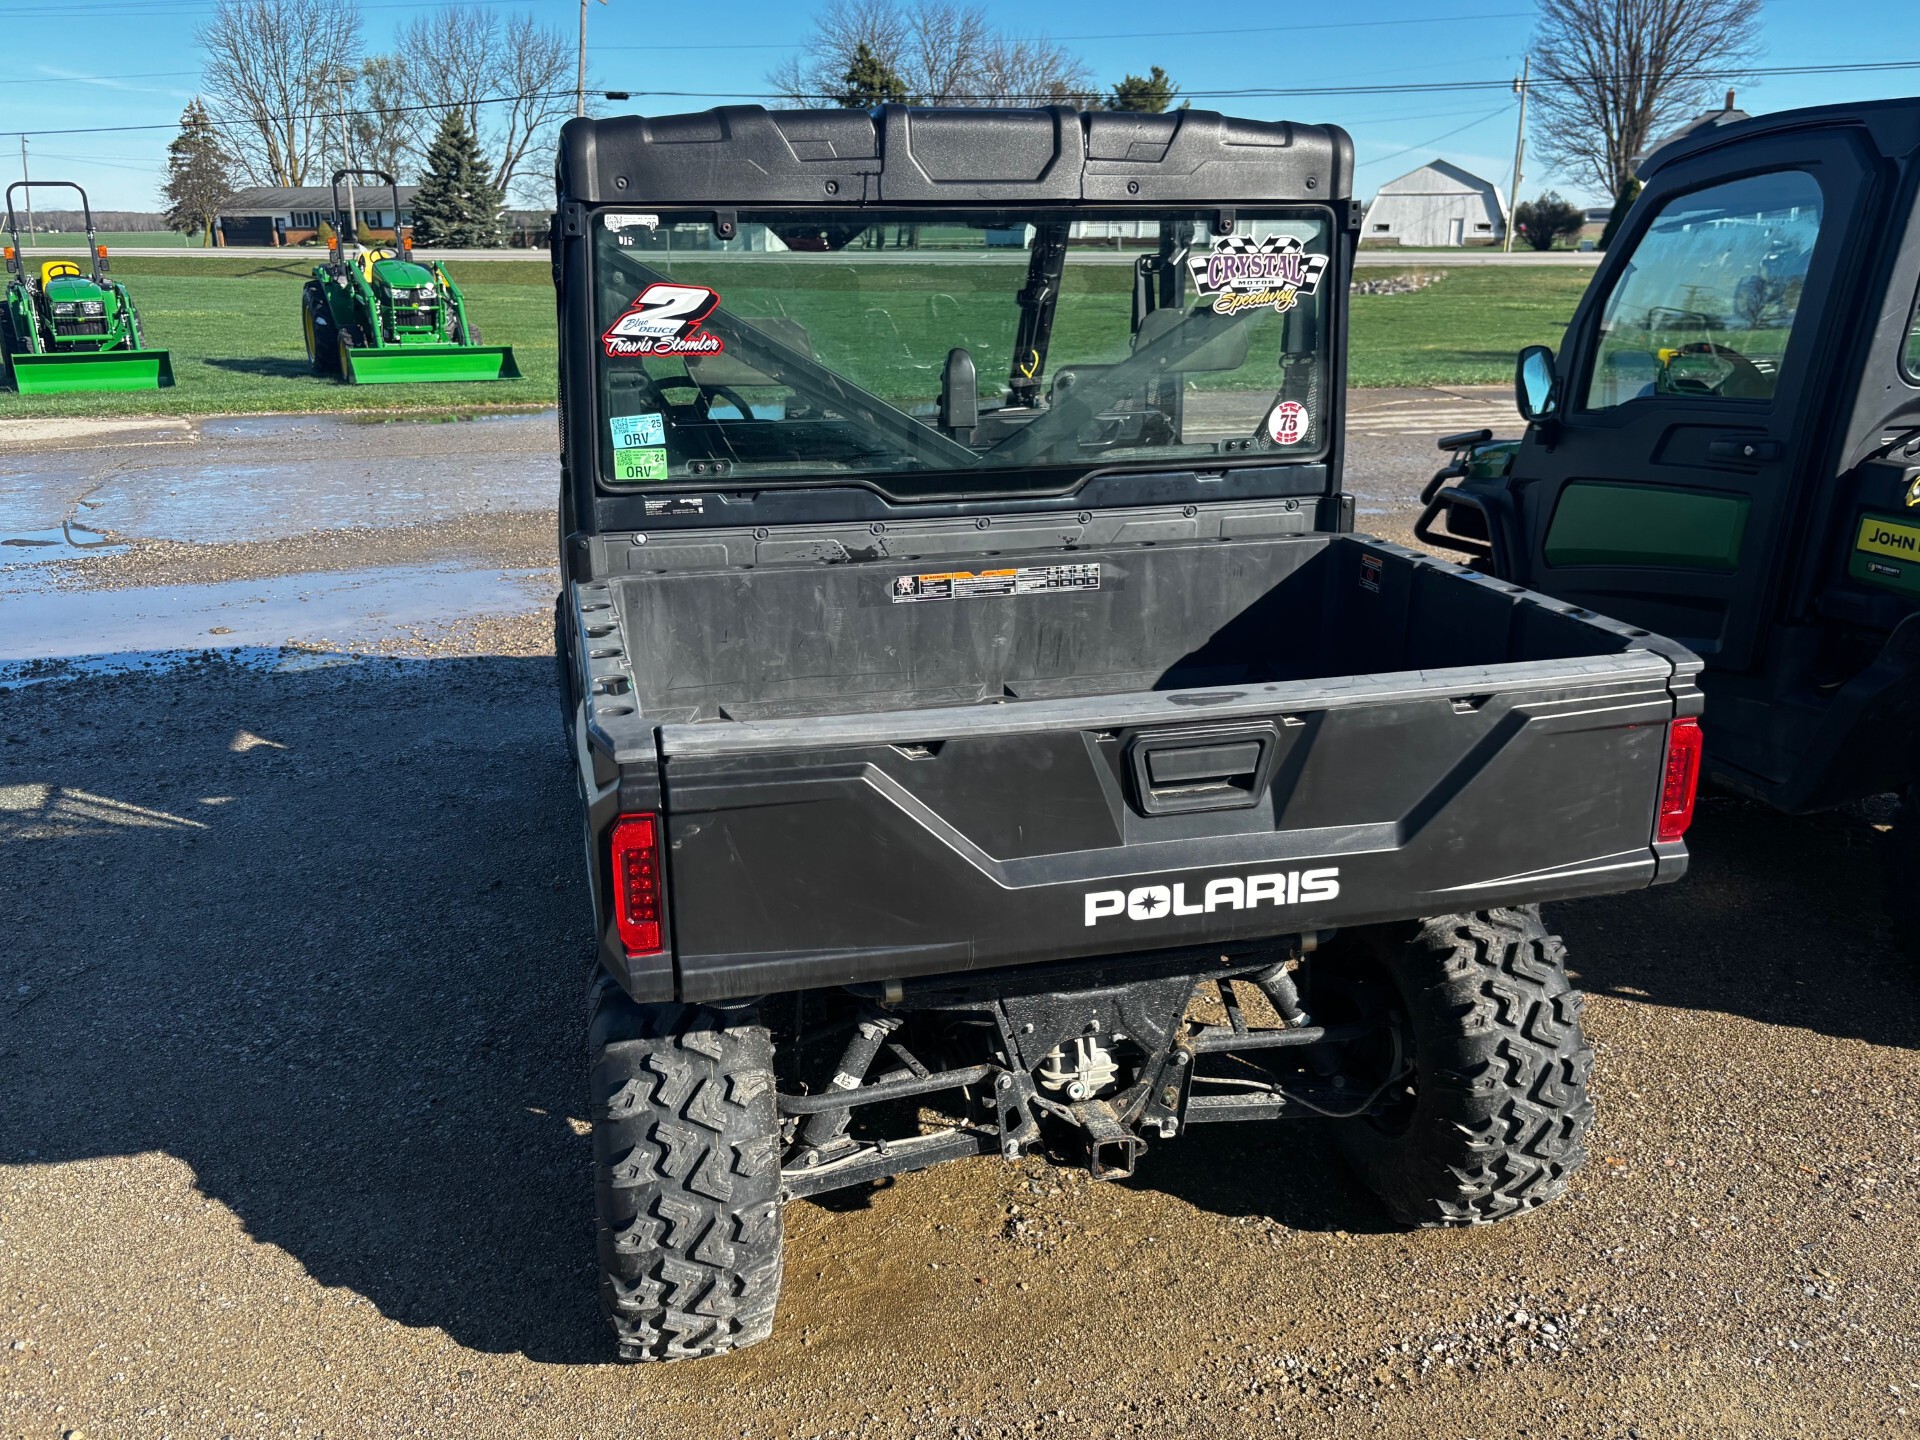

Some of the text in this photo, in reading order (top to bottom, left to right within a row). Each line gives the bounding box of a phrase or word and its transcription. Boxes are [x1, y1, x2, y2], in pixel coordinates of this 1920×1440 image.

[1207, 253, 1305, 288] CRYSTAL
[1214, 286, 1297, 313] Speedway
[609, 285, 711, 338] 2
[623, 318, 649, 331] Blue
[638, 326, 677, 334] DEUCE
[605, 332, 720, 353] Travis Stemler
[651, 420, 662, 428] 25
[1280, 414, 1298, 431] 75
[624, 432, 649, 446] ORV
[654, 454, 665, 462] 24
[626, 466, 651, 478] ORV
[1868, 528, 1915, 551] JOHN
[1084, 867, 1340, 927] POLARIS
